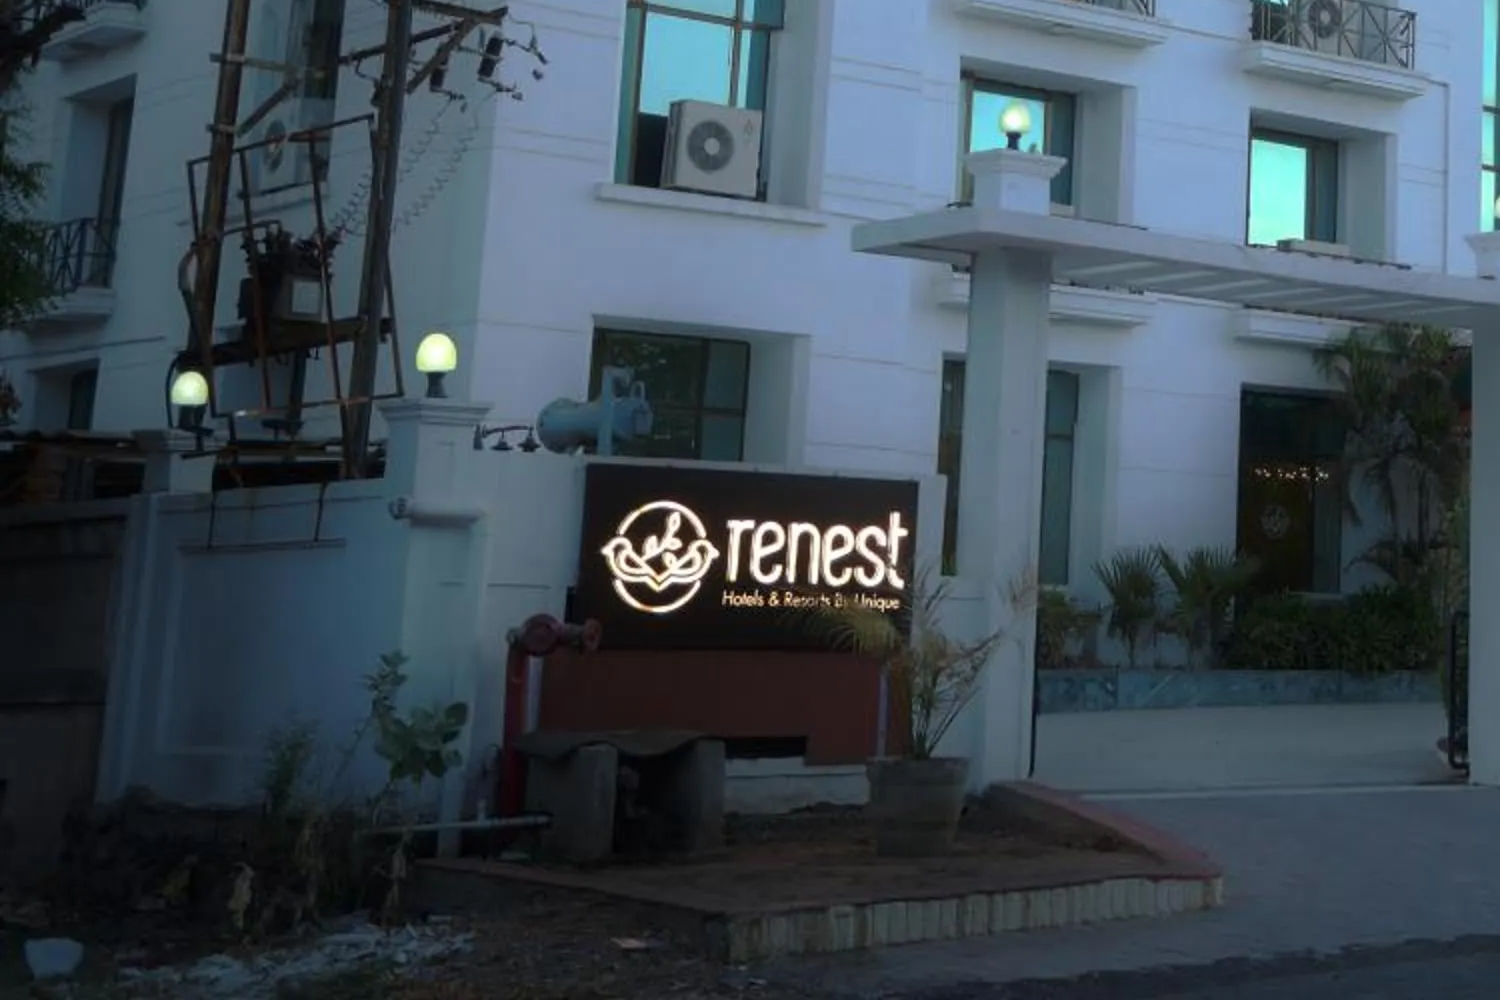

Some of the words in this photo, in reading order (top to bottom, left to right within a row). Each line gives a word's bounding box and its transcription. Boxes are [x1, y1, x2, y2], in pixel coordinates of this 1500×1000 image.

[727, 511, 908, 589] renest
[722, 590, 763, 607] Hotels
[768, 592, 780, 607] &
[783, 591, 832, 608] Resorts
